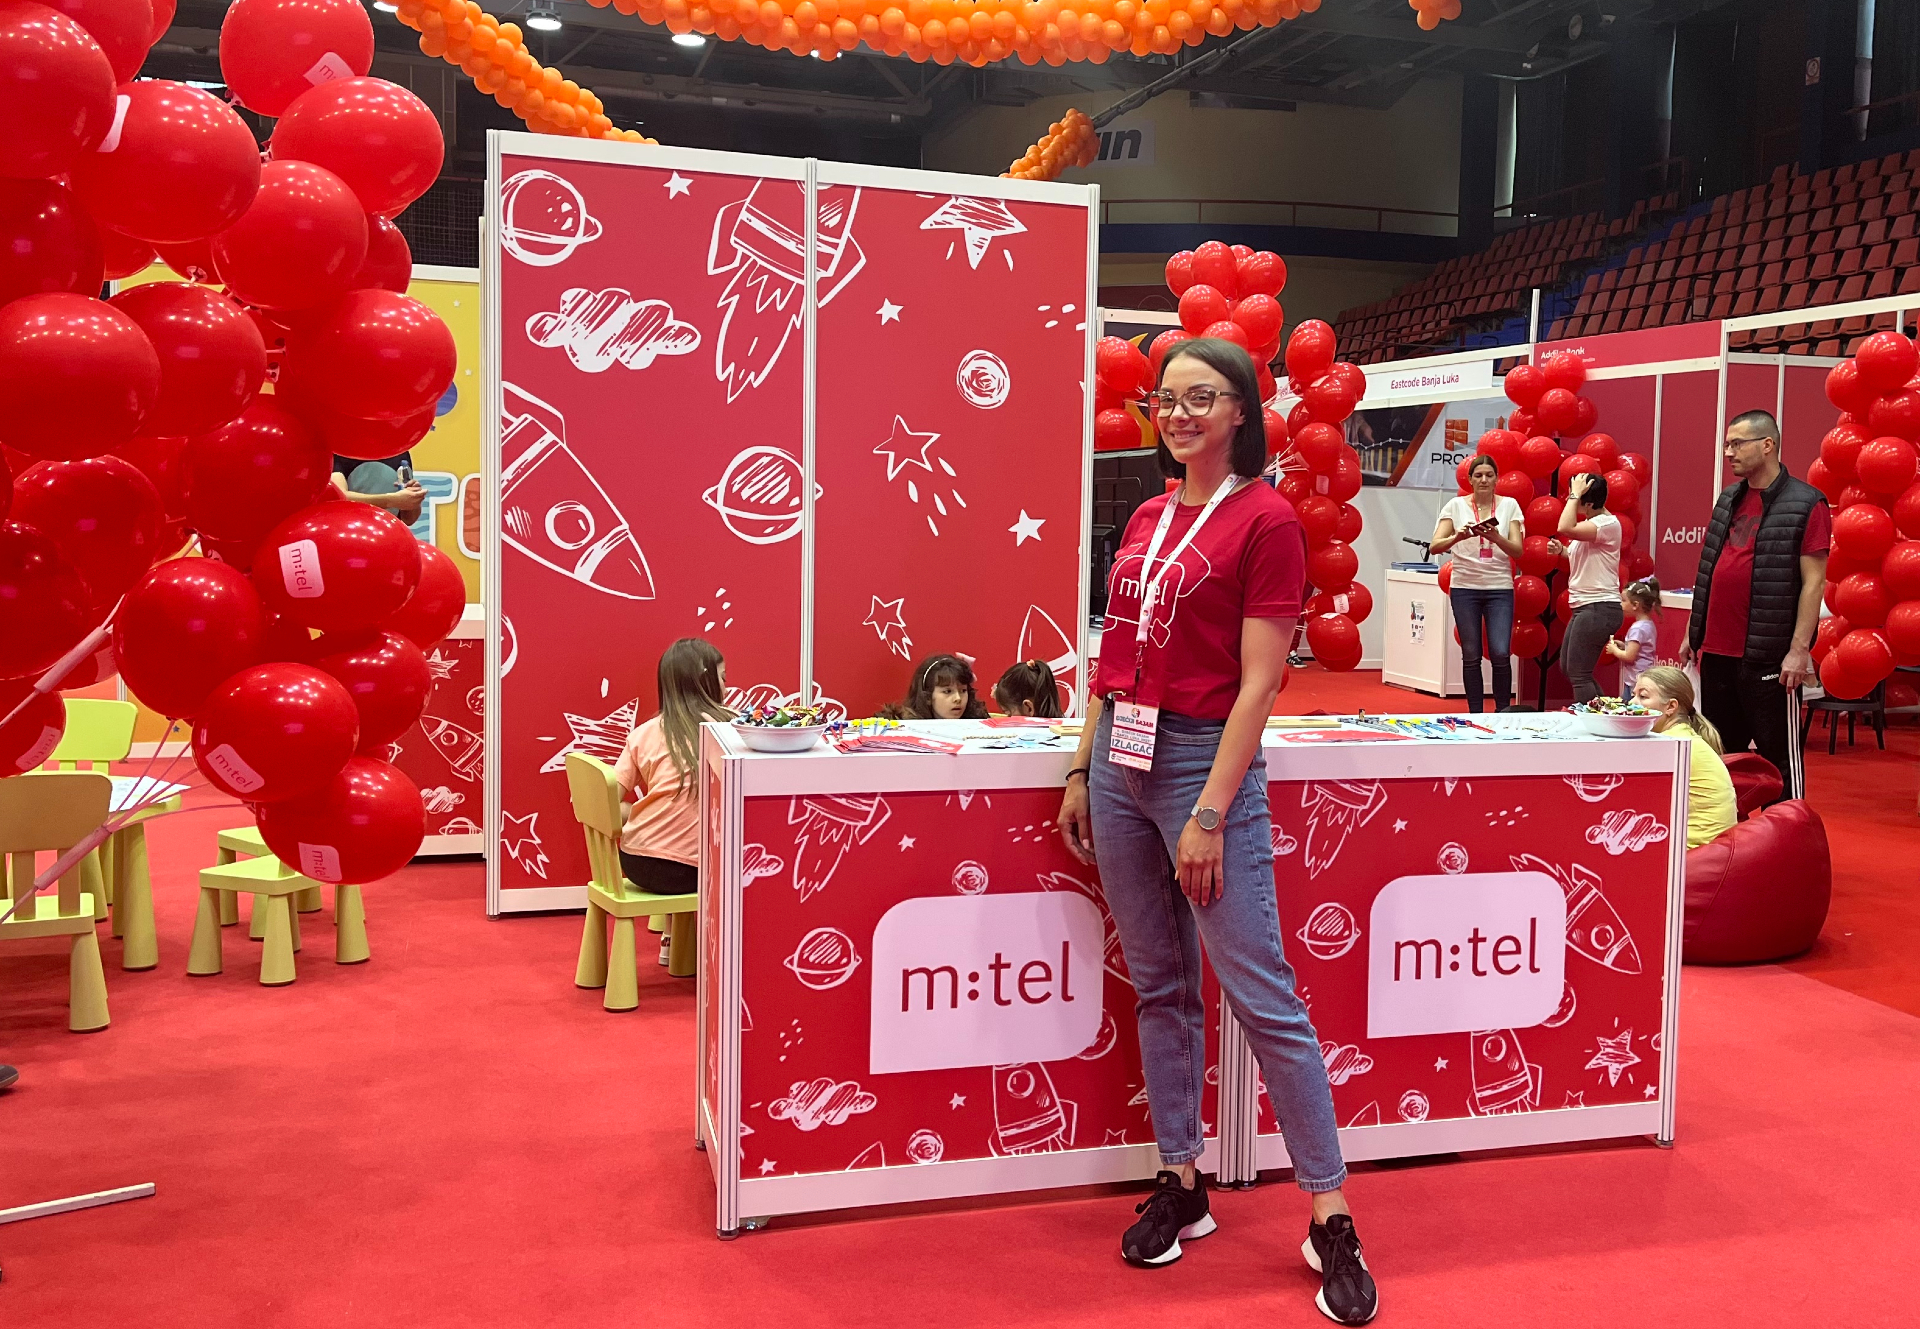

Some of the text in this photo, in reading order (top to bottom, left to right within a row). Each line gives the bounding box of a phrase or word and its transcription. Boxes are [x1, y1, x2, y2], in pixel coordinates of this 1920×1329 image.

[1096, 130, 1142, 160] in
[1391, 373, 1459, 389] Eastcode Banja Luka
[1431, 453, 1469, 465] PRO
[291, 548, 313, 591] m:tel
[1111, 738, 1153, 756] IZLAGAČ
[215, 754, 253, 788] m:tel
[311, 850, 331, 878] m:tel
[1394, 917, 1541, 981] m:tel
[901, 940, 1075, 1012] m:tel
